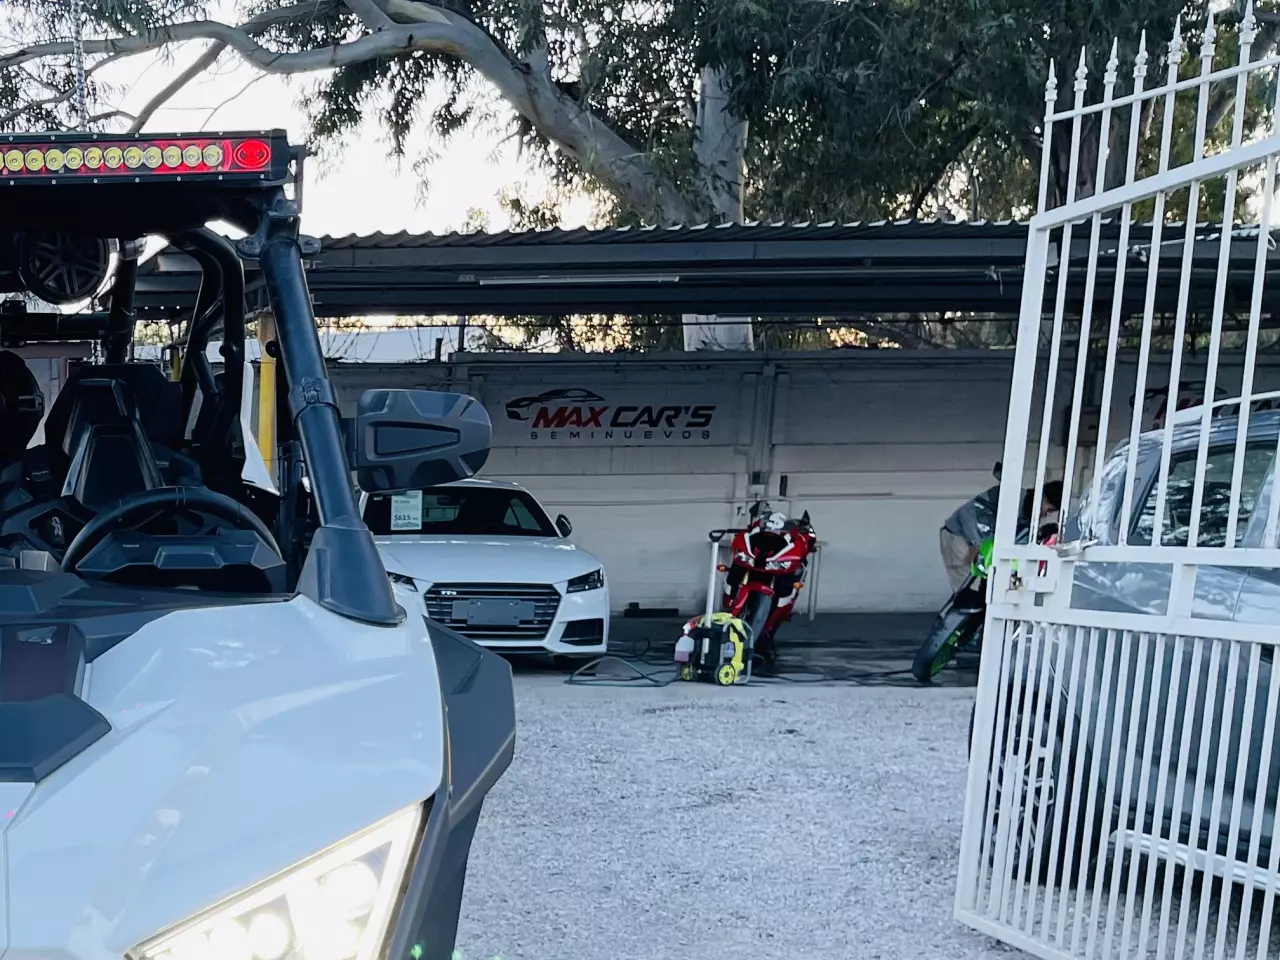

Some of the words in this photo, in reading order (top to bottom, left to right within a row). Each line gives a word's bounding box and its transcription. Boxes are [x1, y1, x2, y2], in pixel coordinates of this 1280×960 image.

[531, 405, 610, 429] MAX
[609, 405, 717, 428] CAR'S
[530, 430, 711, 440] SEMINUEVOS
